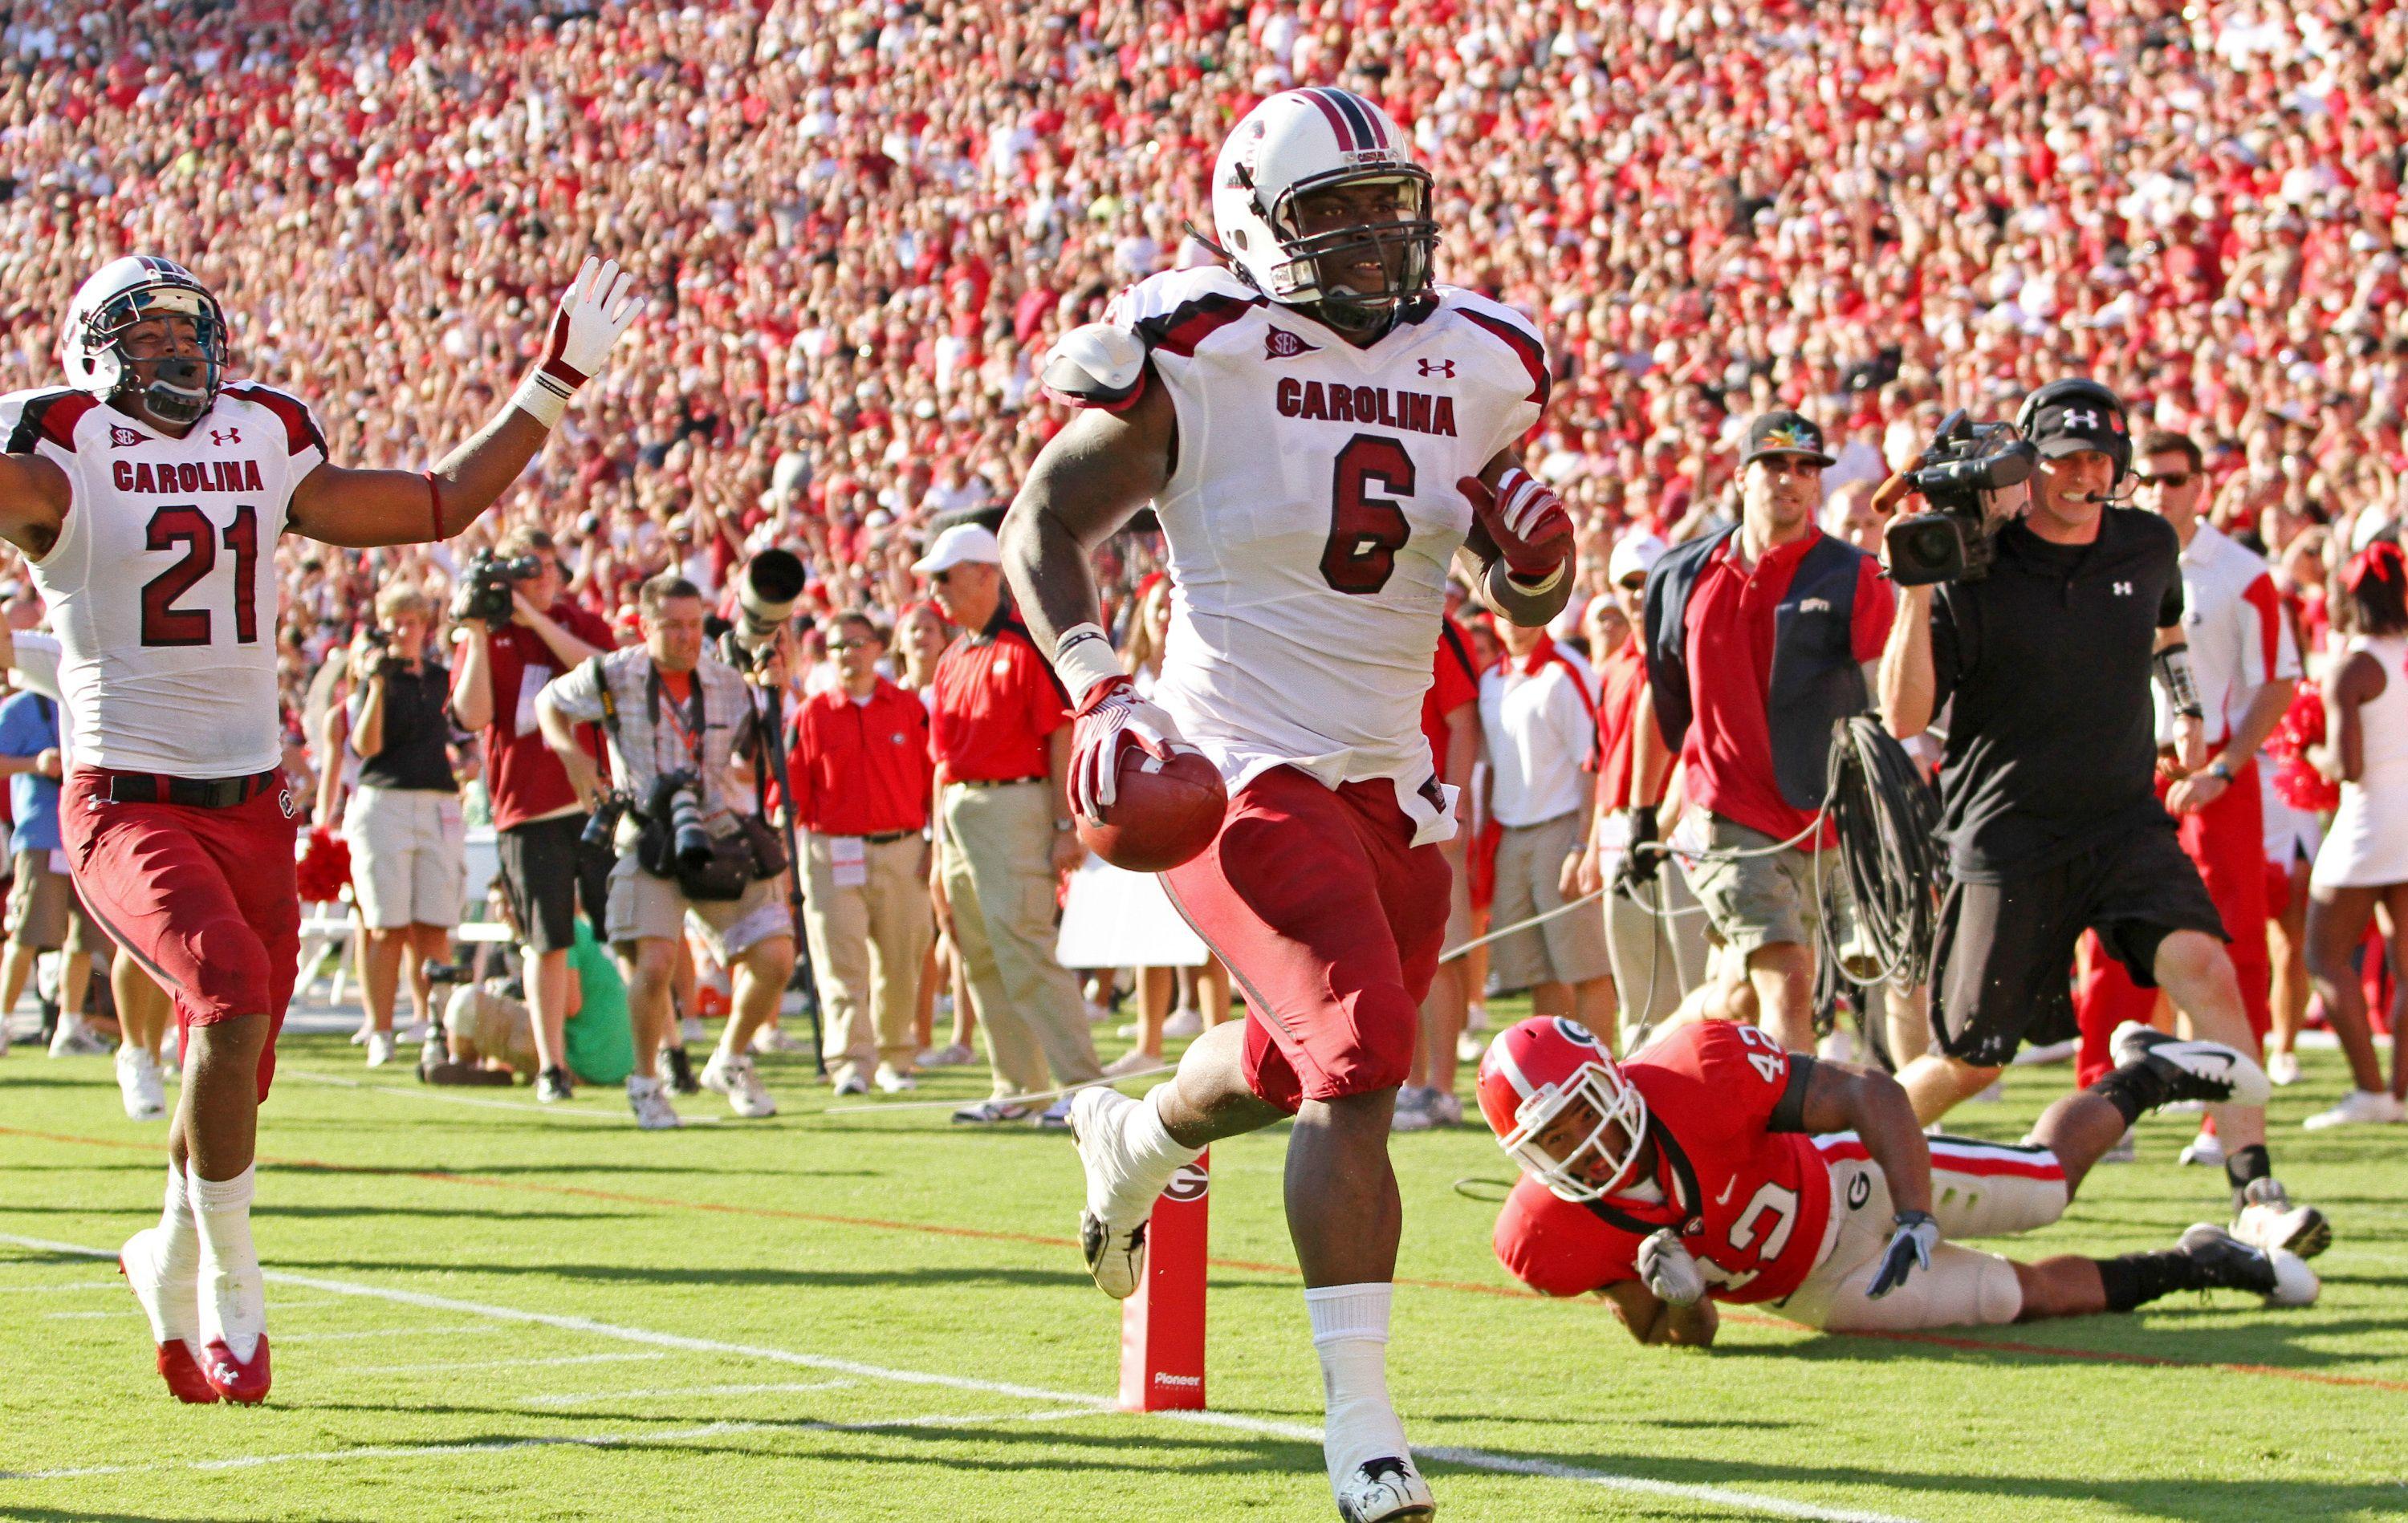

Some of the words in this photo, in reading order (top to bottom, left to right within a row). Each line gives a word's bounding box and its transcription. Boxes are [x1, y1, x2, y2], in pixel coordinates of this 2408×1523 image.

[1274, 334, 1298, 354] SEC
[1276, 376, 1458, 437] CAROLINA
[116, 429, 135, 445] SEC
[113, 460, 264, 493] CAROLINA
[1319, 433, 1416, 595] 6
[140, 505, 258, 647] 21
[1737, 1025, 1784, 1083] 42
[1161, 1164, 1209, 1200] G
[1848, 1171, 1870, 1211] G
[1155, 1371, 1201, 1387] Pioneer
